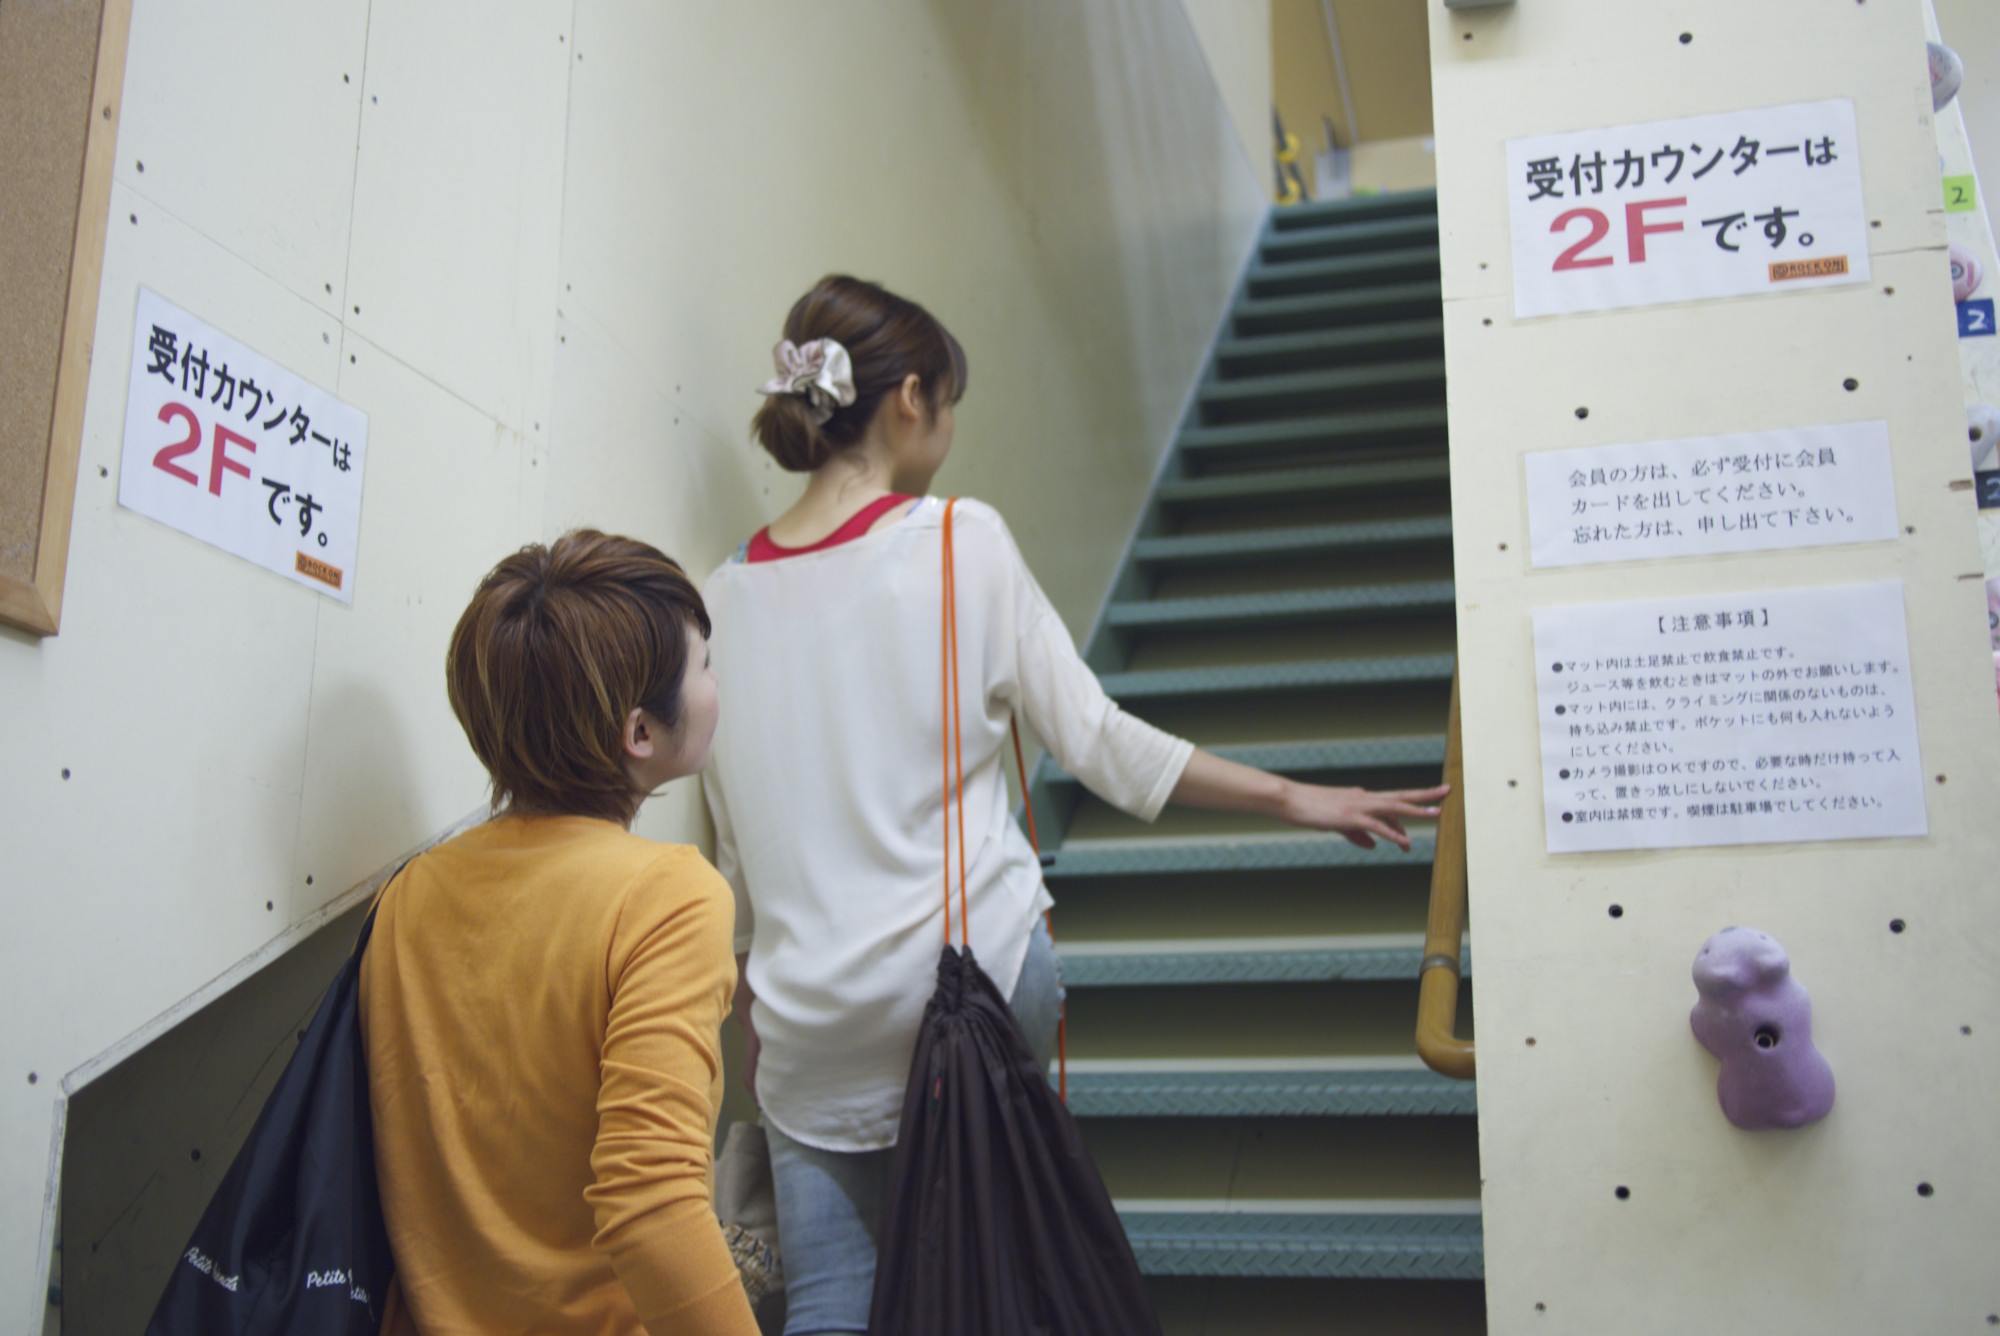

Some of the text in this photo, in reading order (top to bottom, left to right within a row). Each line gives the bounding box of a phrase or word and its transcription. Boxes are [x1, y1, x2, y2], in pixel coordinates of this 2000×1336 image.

[1526, 135, 1838, 202] 受付カウンターは
[1951, 185, 1968, 205] 2
[147, 324, 352, 472] 受付カウンターは
[1568, 446, 1837, 488] 会員の方は、必ず受付に会員
[1571, 481, 1806, 515] カードを出してください。
[1572, 506, 1854, 545] 忘れた方は、申し出て下さい。
[1658, 608, 1769, 634] 【注意事項】
[1570, 741, 1675, 758] にしてください。
[1574, 776, 1822, 801] って、置きっ放しにしないでください。
[307, 1269, 346, 1289] Petite
